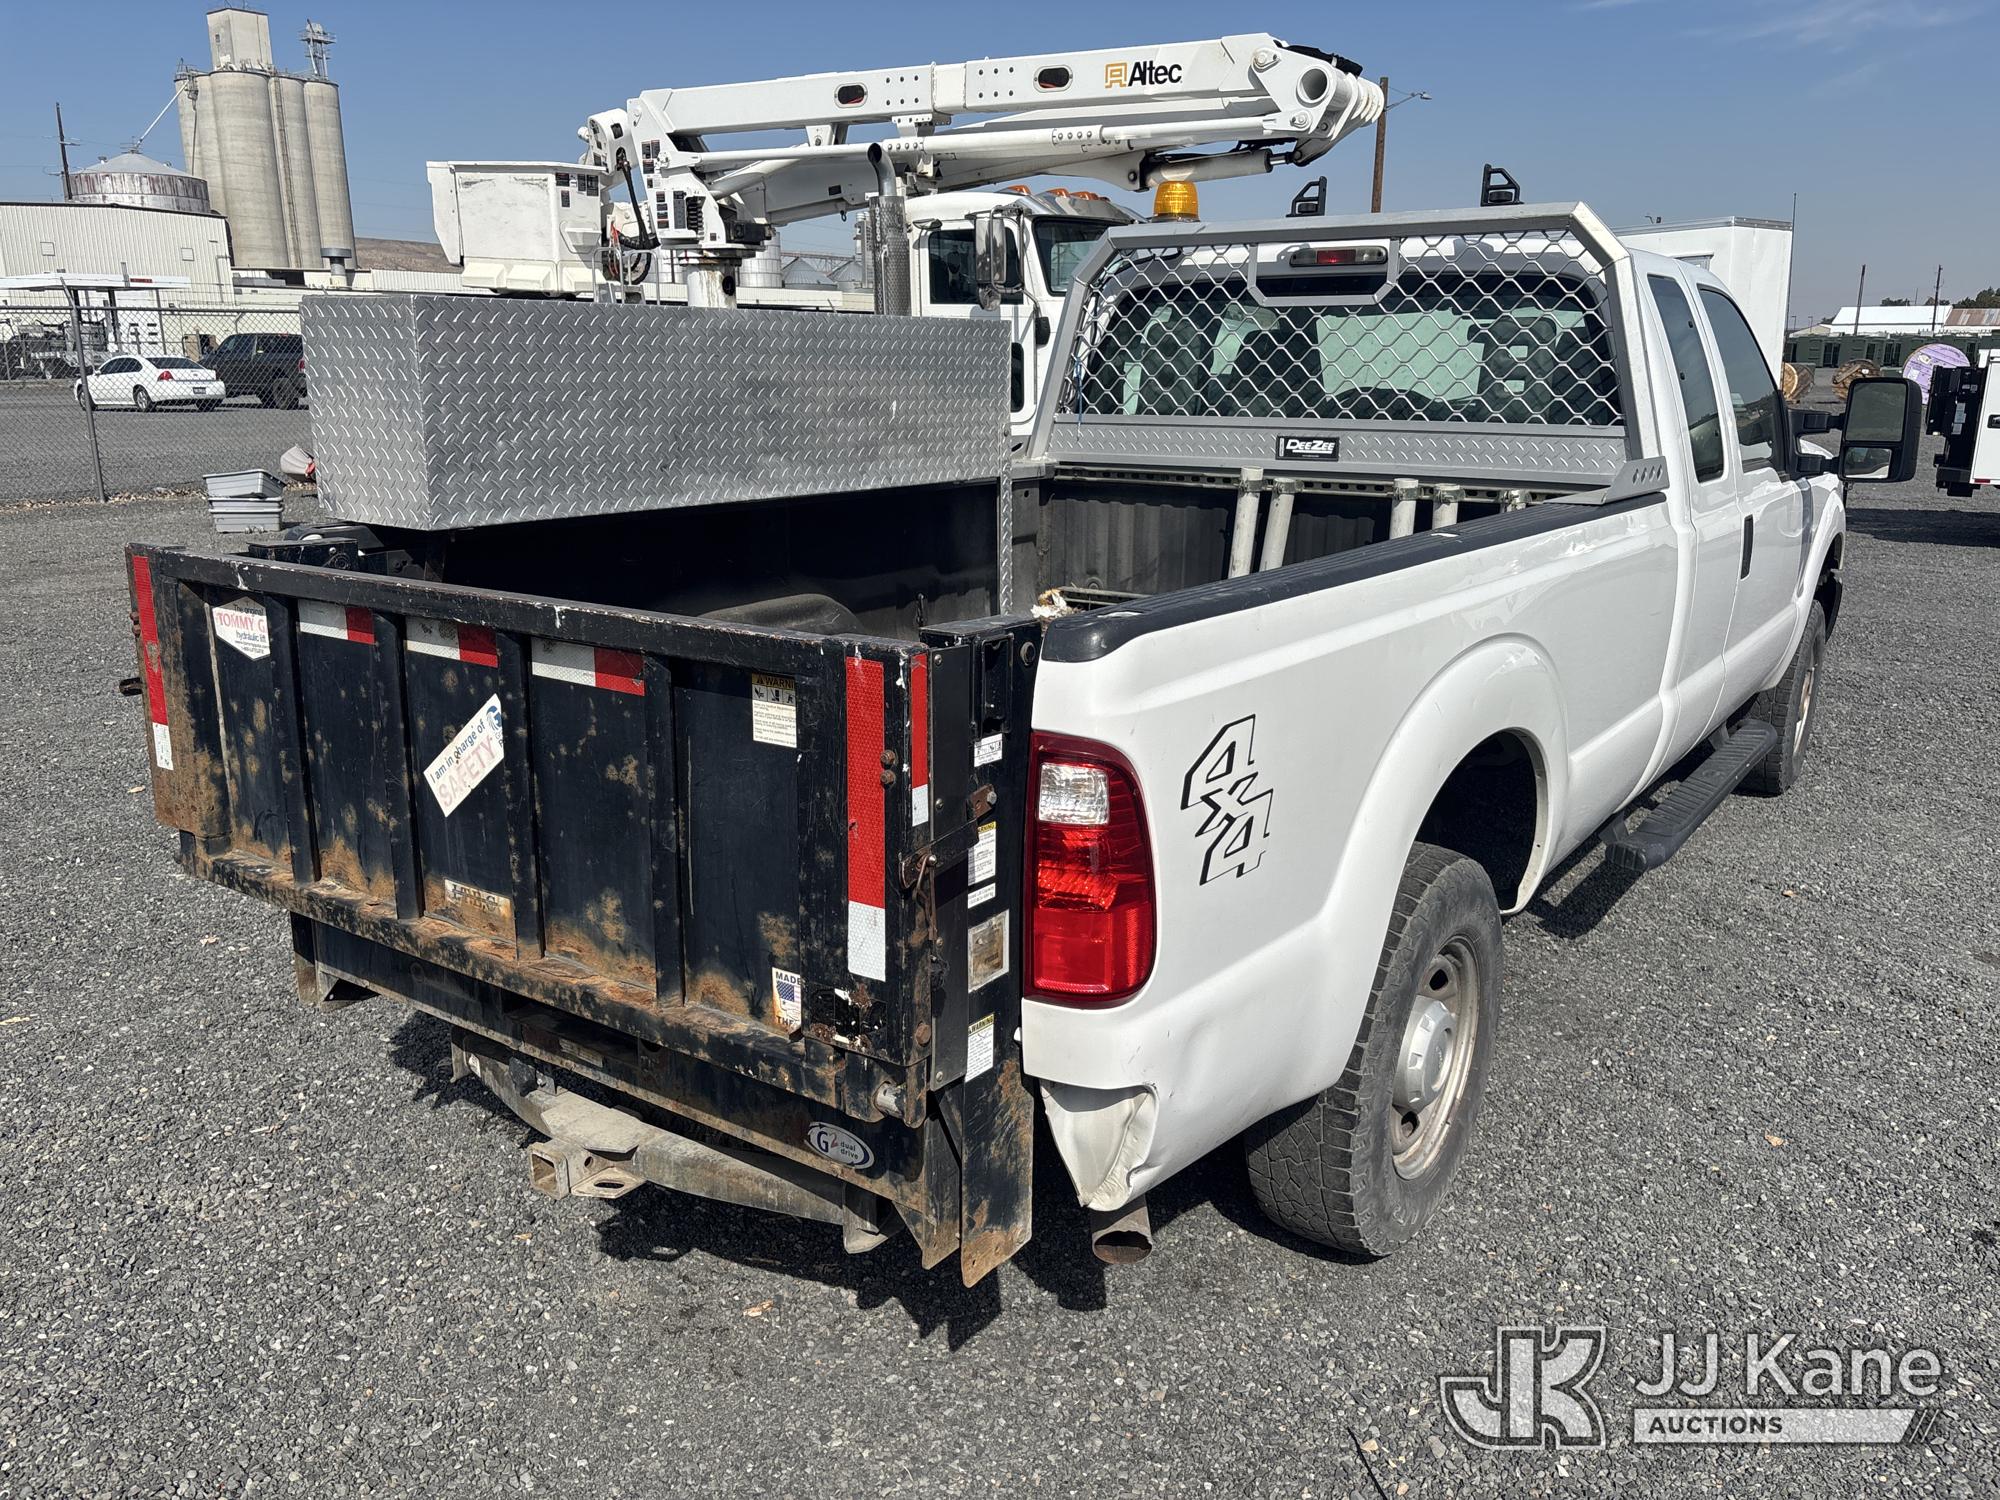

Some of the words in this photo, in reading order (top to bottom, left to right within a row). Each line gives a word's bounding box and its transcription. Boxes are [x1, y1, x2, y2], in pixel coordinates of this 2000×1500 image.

[1127, 60, 1183, 87] Altec
[216, 612, 254, 631] TOMMY
[765, 676, 796, 690] WARNI
[430, 773, 437, 784] I
[435, 764, 448, 780] am
[446, 755, 455, 768] in
[453, 730, 478, 759] charge
[476, 719, 486, 735] of
[438, 735, 496, 808] SAFETY
[775, 971, 802, 986] MADE
[840, 1141, 857, 1153] dual
[840, 1149, 860, 1161] drive
